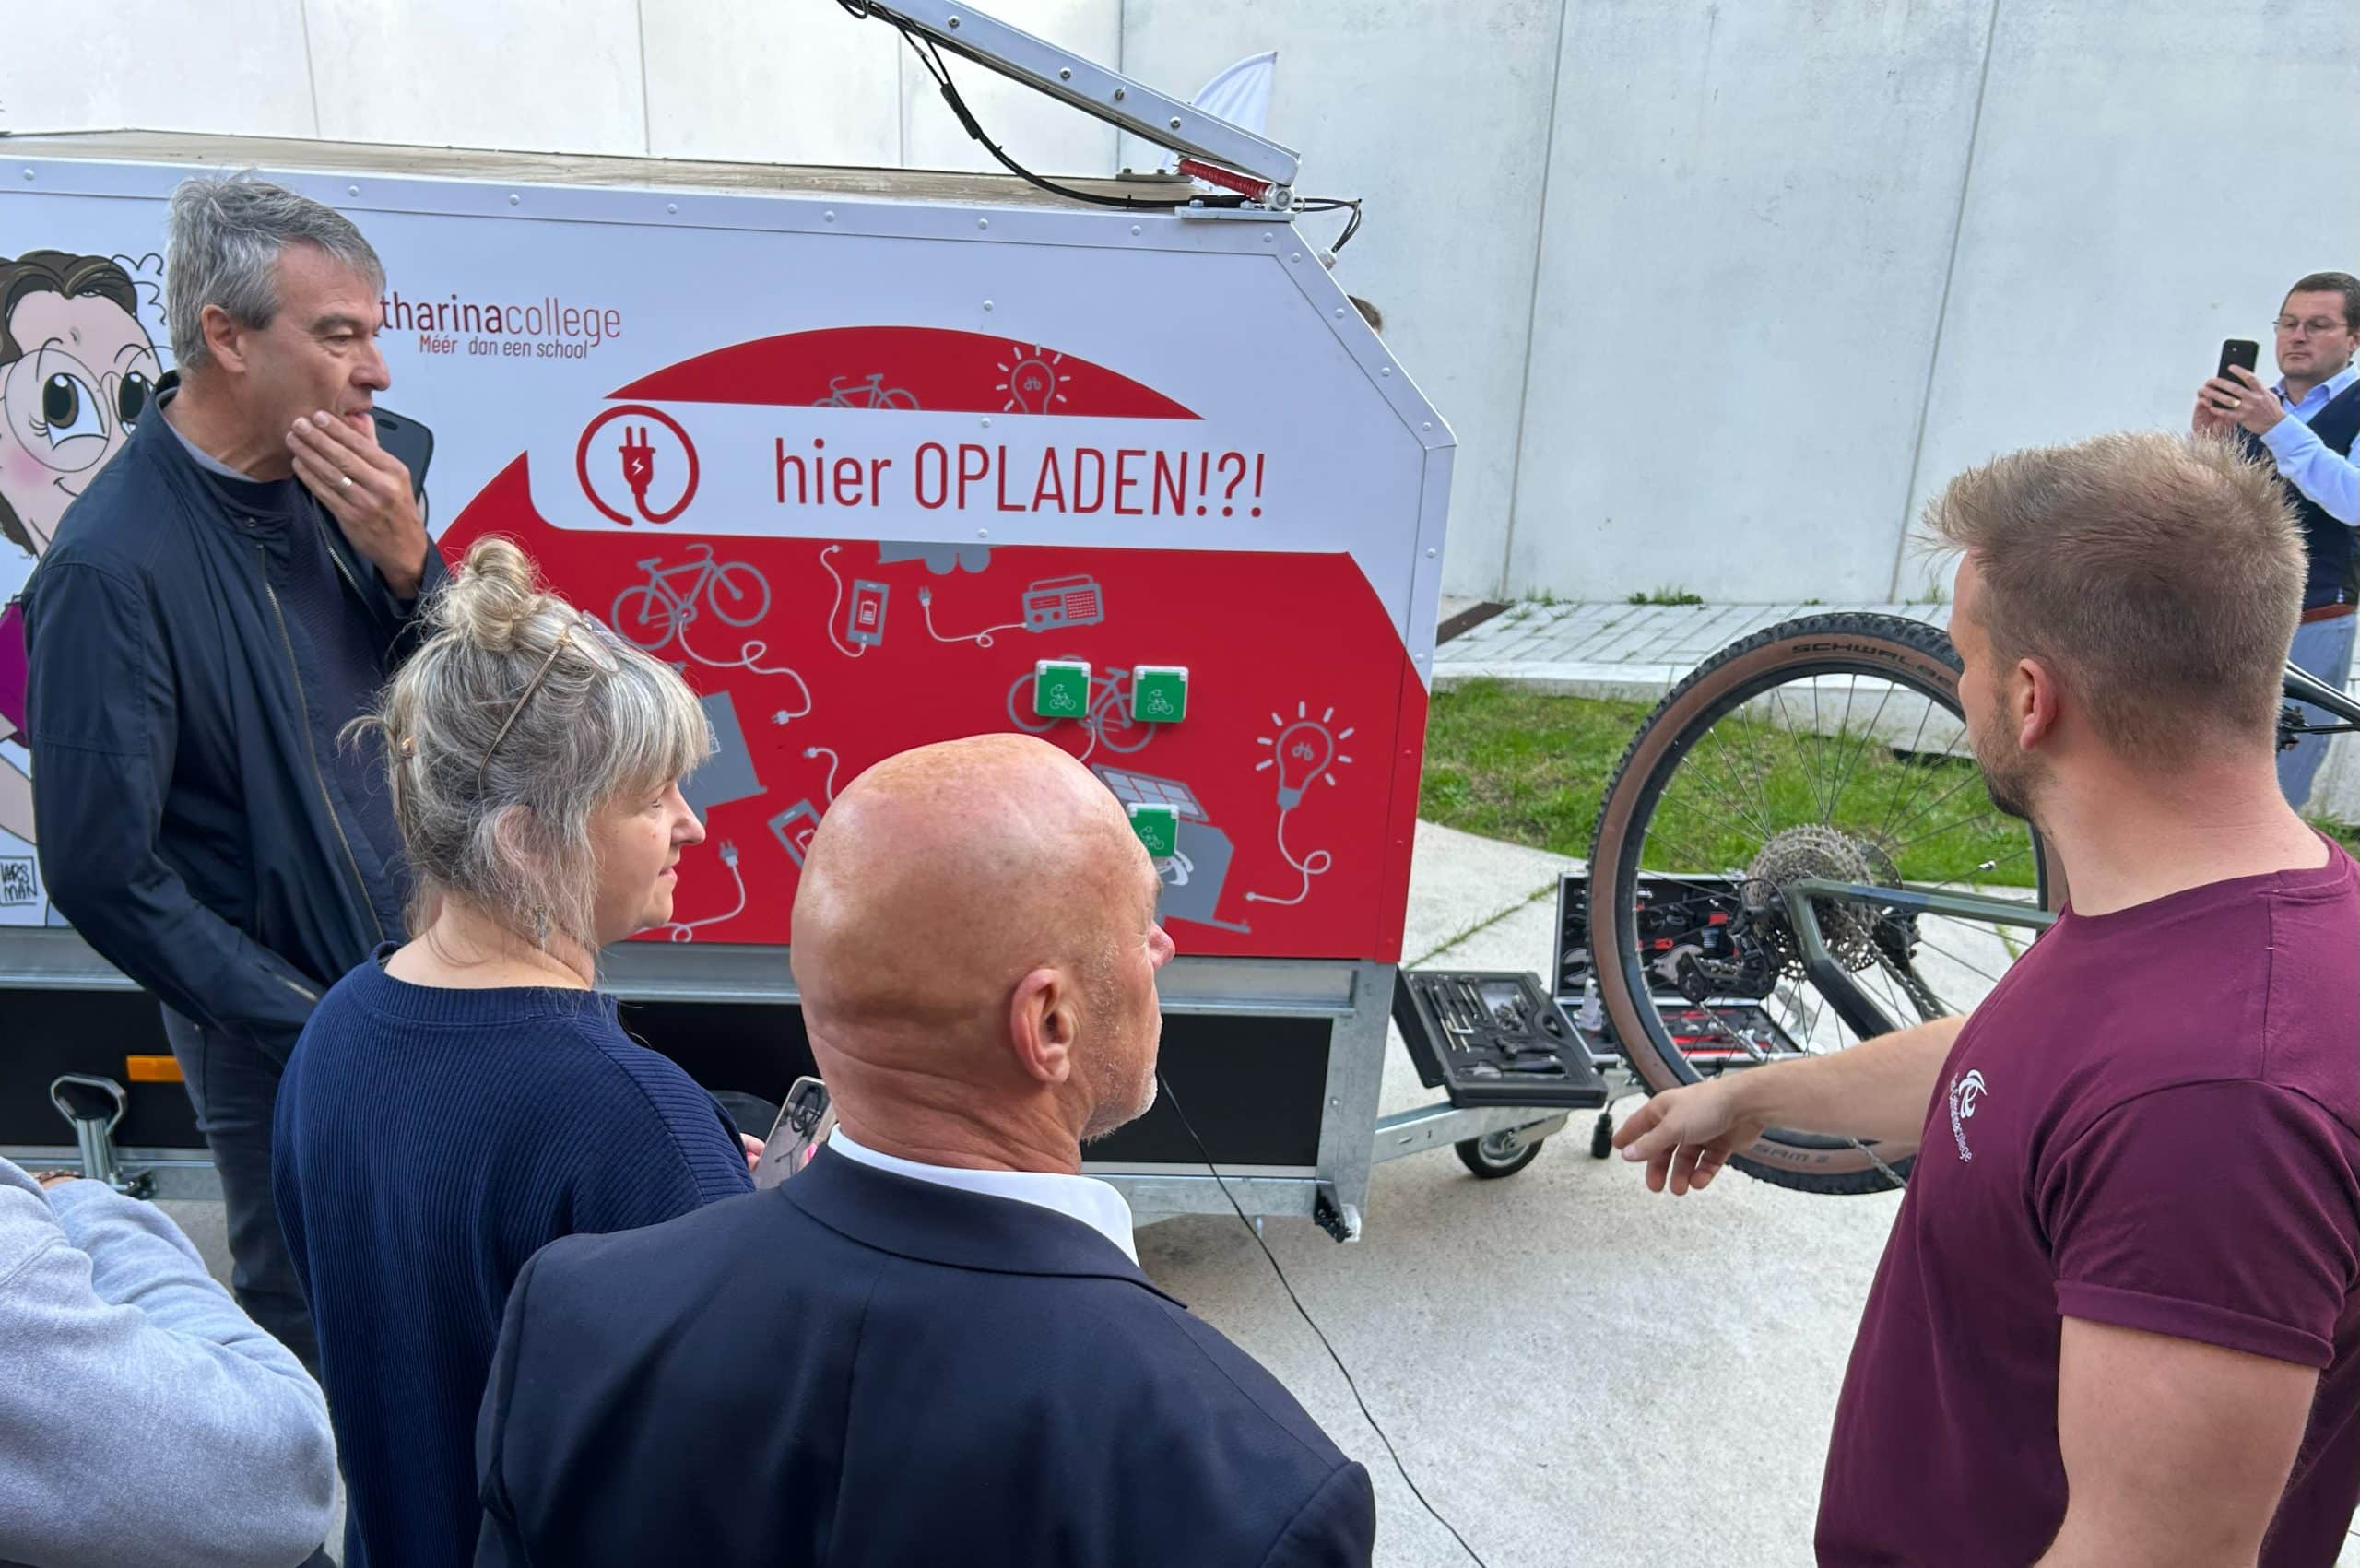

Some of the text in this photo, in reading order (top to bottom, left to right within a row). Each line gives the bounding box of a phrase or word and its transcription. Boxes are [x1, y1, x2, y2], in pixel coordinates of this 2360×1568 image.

[419, 333, 588, 360] Méér dan een school
[775, 437, 1266, 518] hier OPLADEN!?!
